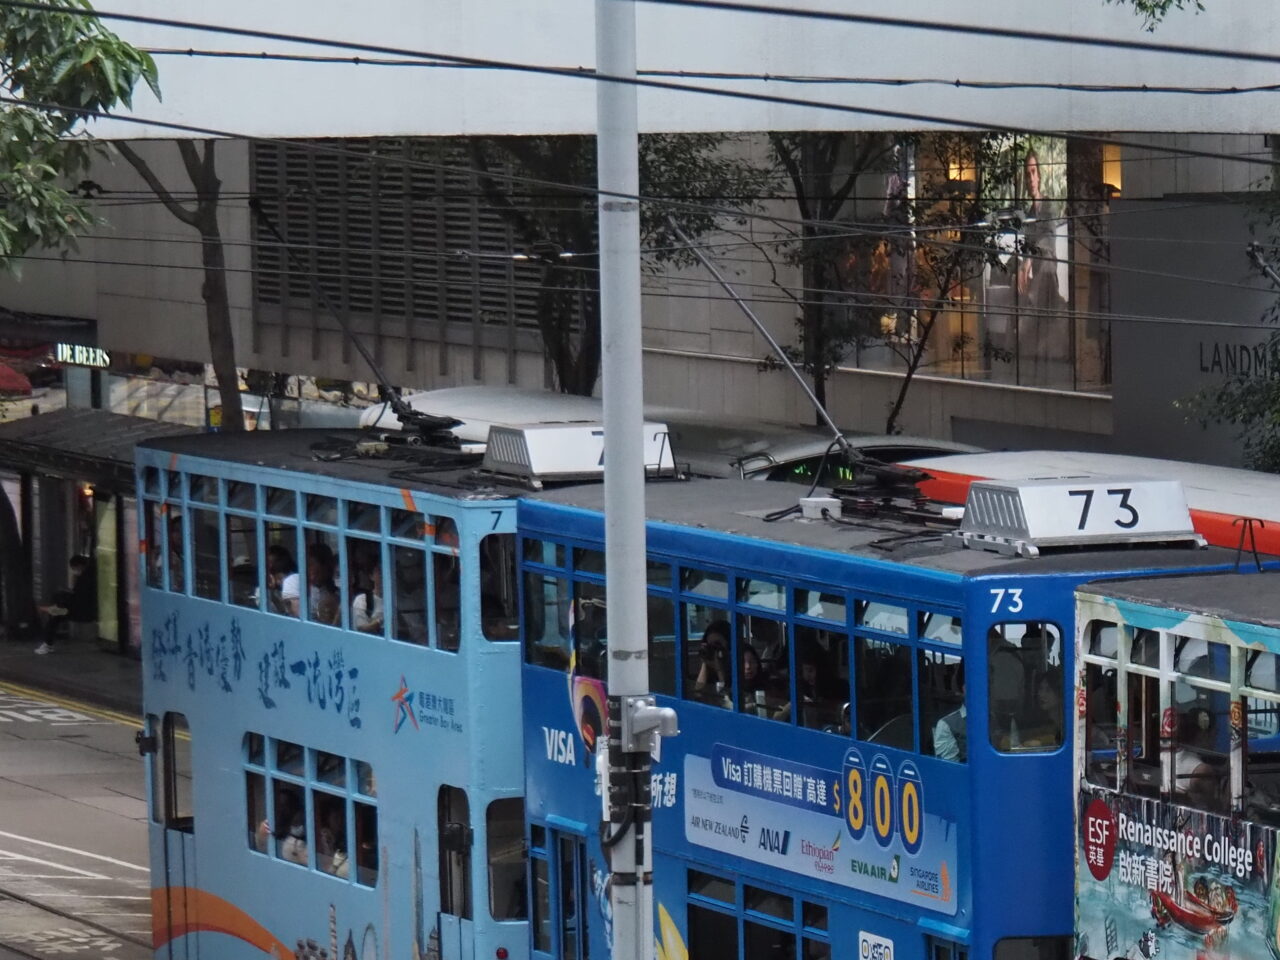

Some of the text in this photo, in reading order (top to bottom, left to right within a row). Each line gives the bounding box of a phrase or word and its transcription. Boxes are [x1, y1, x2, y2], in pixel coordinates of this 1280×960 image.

[57, 343, 110, 367] DE BEERS
[1200, 342, 1267, 378] LANDM
[490, 511, 502, 531] 7
[1068, 488, 1139, 530] 73
[990, 588, 1024, 613] 73
[542, 726, 576, 766] VISA
[721, 757, 742, 783] Visa
[691, 815, 740, 840] AIR NEW ZEALAND
[1088, 816, 1110, 845] ESF
[759, 827, 781, 855] ANA
[801, 839, 834, 861] Ethiopian
[1118, 812, 1253, 878] Renaissance College
[1088, 846, 1105, 867] 英基
[910, 866, 939, 884] SINGAPORE
[916, 879, 939, 895] AIRLINES
